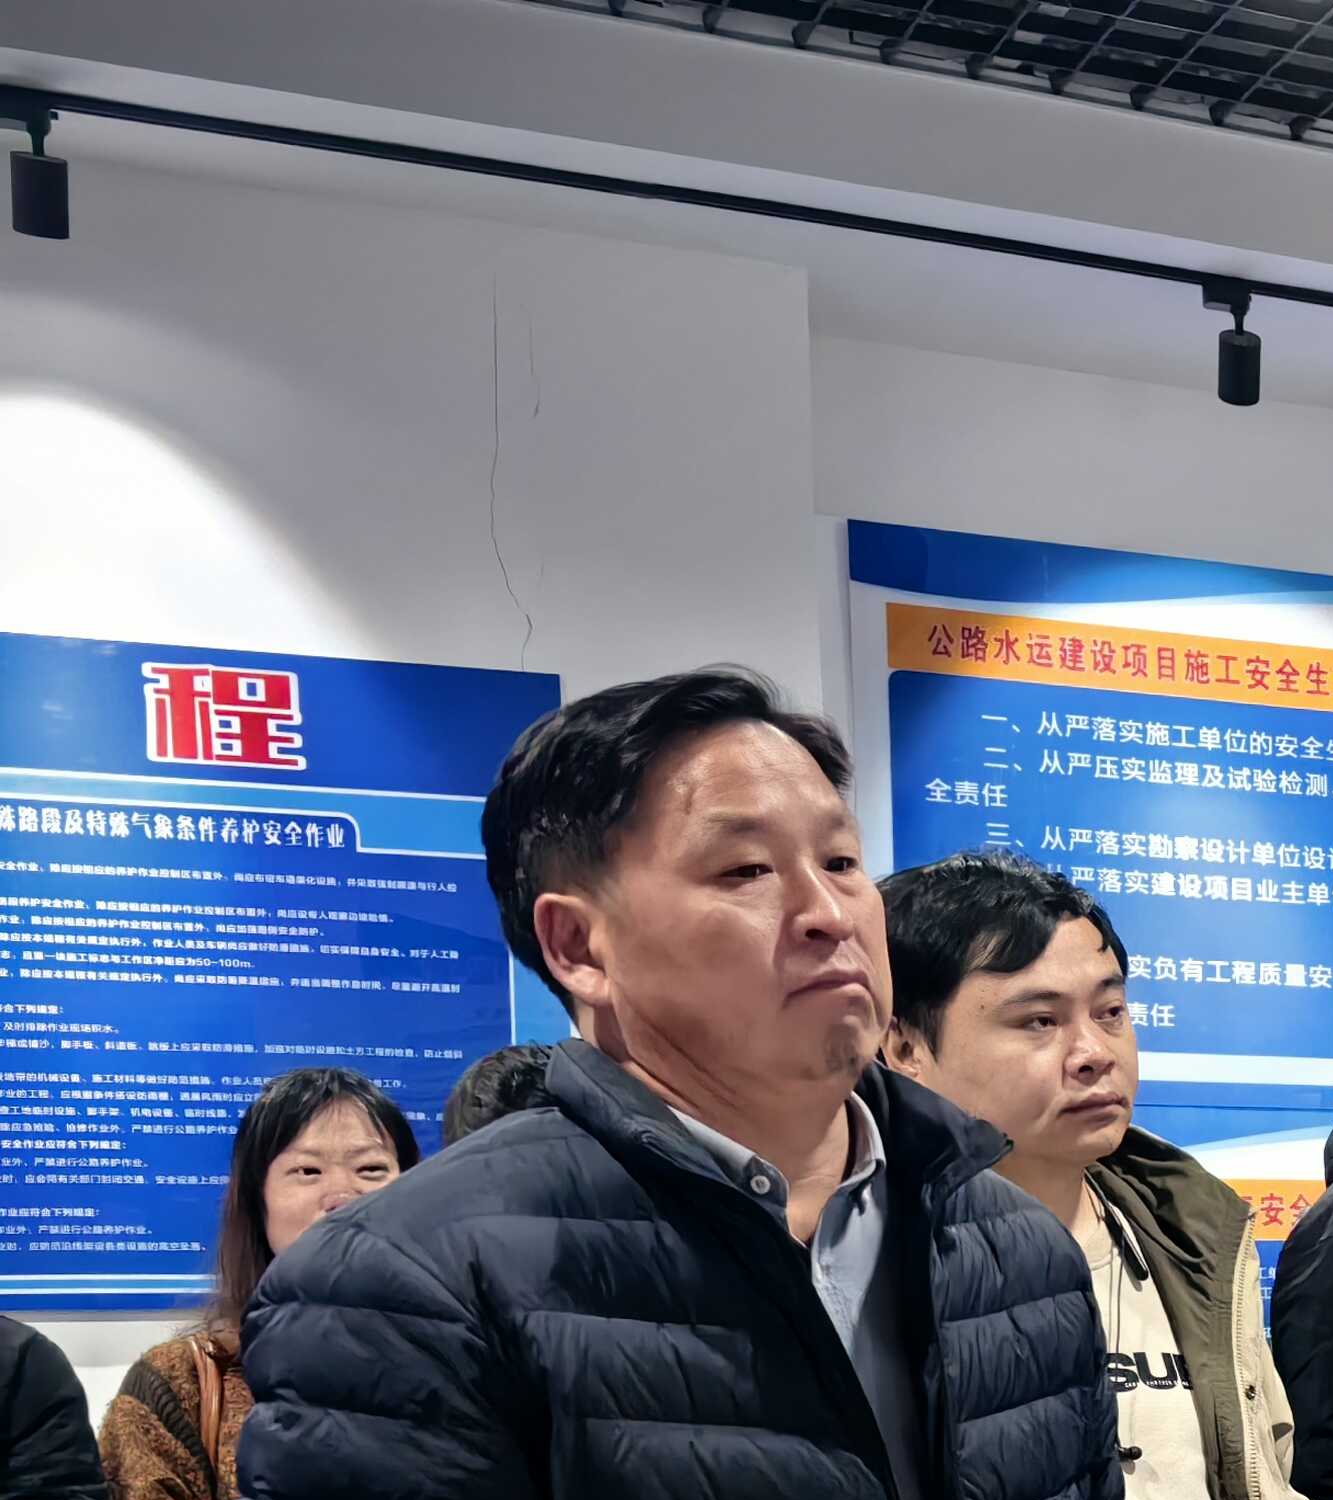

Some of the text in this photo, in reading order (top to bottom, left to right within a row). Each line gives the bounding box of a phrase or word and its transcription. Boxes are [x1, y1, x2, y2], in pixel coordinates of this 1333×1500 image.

[142, 662, 306, 770] 程
[925, 778, 1008, 807] 全责任
[1128, 1002, 1177, 1028] 责任
